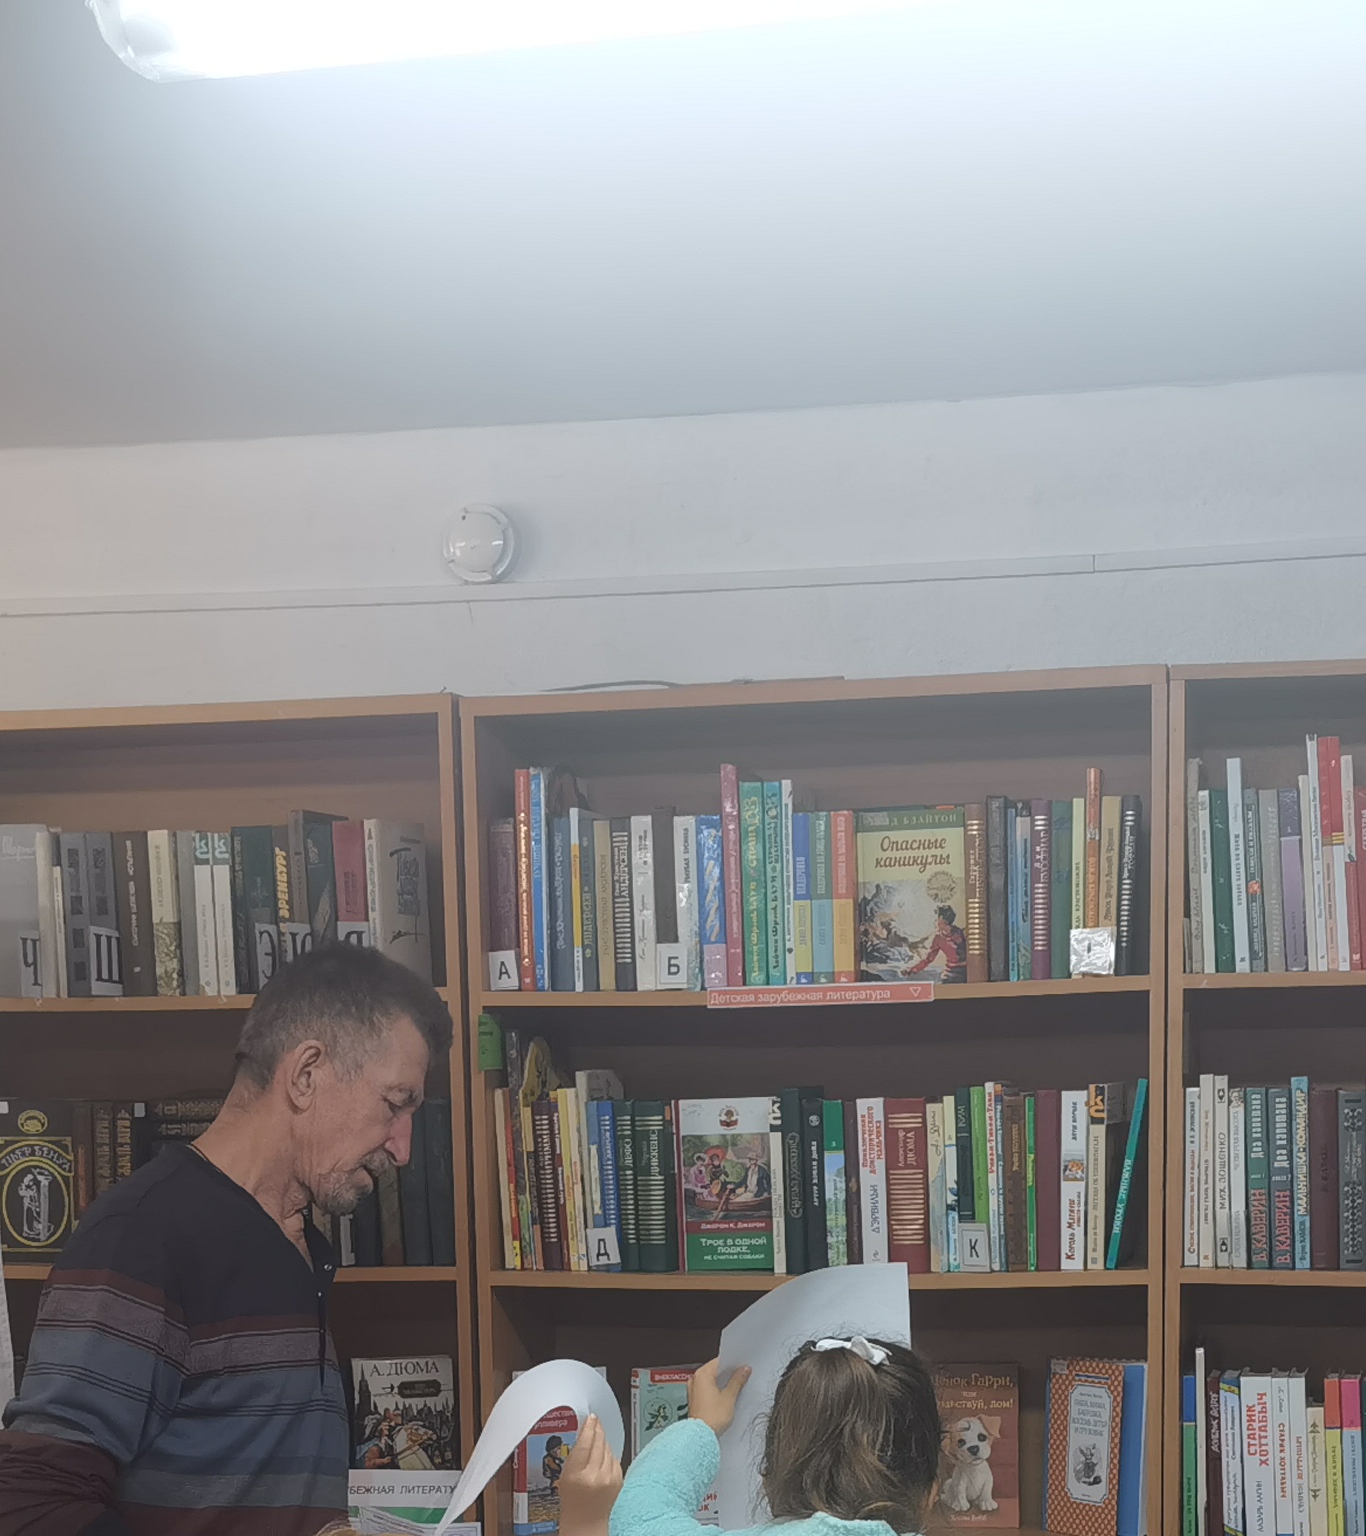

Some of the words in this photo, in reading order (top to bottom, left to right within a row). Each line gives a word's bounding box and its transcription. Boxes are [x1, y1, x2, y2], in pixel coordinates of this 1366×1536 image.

[880, 836, 946, 852] Опасные
[619, 846, 629, 897] АНДЕРСЕН
[875, 853, 951, 873] каникулы
[275, 847, 289, 918] ЭРЕНБУРГ
[92, 932, 123, 984] Ш
[498, 961, 511, 980] А
[667, 956, 680, 975] Б
[710, 990, 753, 1006] Детская
[754, 988, 825, 1004] зарубежная
[827, 987, 891, 1001] литература
[1251, 1094, 1262, 1138] капитана
[1275, 1097, 1287, 1145] капитана
[623, 1138, 633, 1167] ДЕФО
[650, 1129, 659, 1176] ДИККЕНС
[907, 1131, 916, 1165] ДЮМА
[1218, 1132, 1226, 1183] ЗОЩЕНКО
[1251, 1141, 1264, 1158] Два
[1275, 1150, 1290, 1167] Два
[1296, 1089, 1308, 1216] МАЛЬЧИШКА-КОМАНДИР
[1119, 1159, 1132, 1199] ВАЖНЫЕ
[1113, 1202, 1124, 1234] УРОКИ
[1251, 1188, 1266, 1249] КАВЕРИН
[1276, 1190, 1290, 1250] КАВЕРИН
[596, 1239, 610, 1262] Д
[700, 1238, 725, 1246] ТРОЕ
[969, 1238, 979, 1258] К
[1254, 1253, 1267, 1262] В.
[1276, 1253, 1290, 1263] В.
[370, 1363, 385, 1377] А.
[387, 1361, 440, 1376] ДЮМА
[989, 1399, 1014, 1408] дом!
[1246, 1404, 1257, 1456] СТАРИК
[1257, 1392, 1269, 1466] ХОТТАБЫЧ
[348, 1486, 395, 1494] БЕЖНАЯ
[1256, 1505, 1264, 1532] ЛАЗАРЬ
